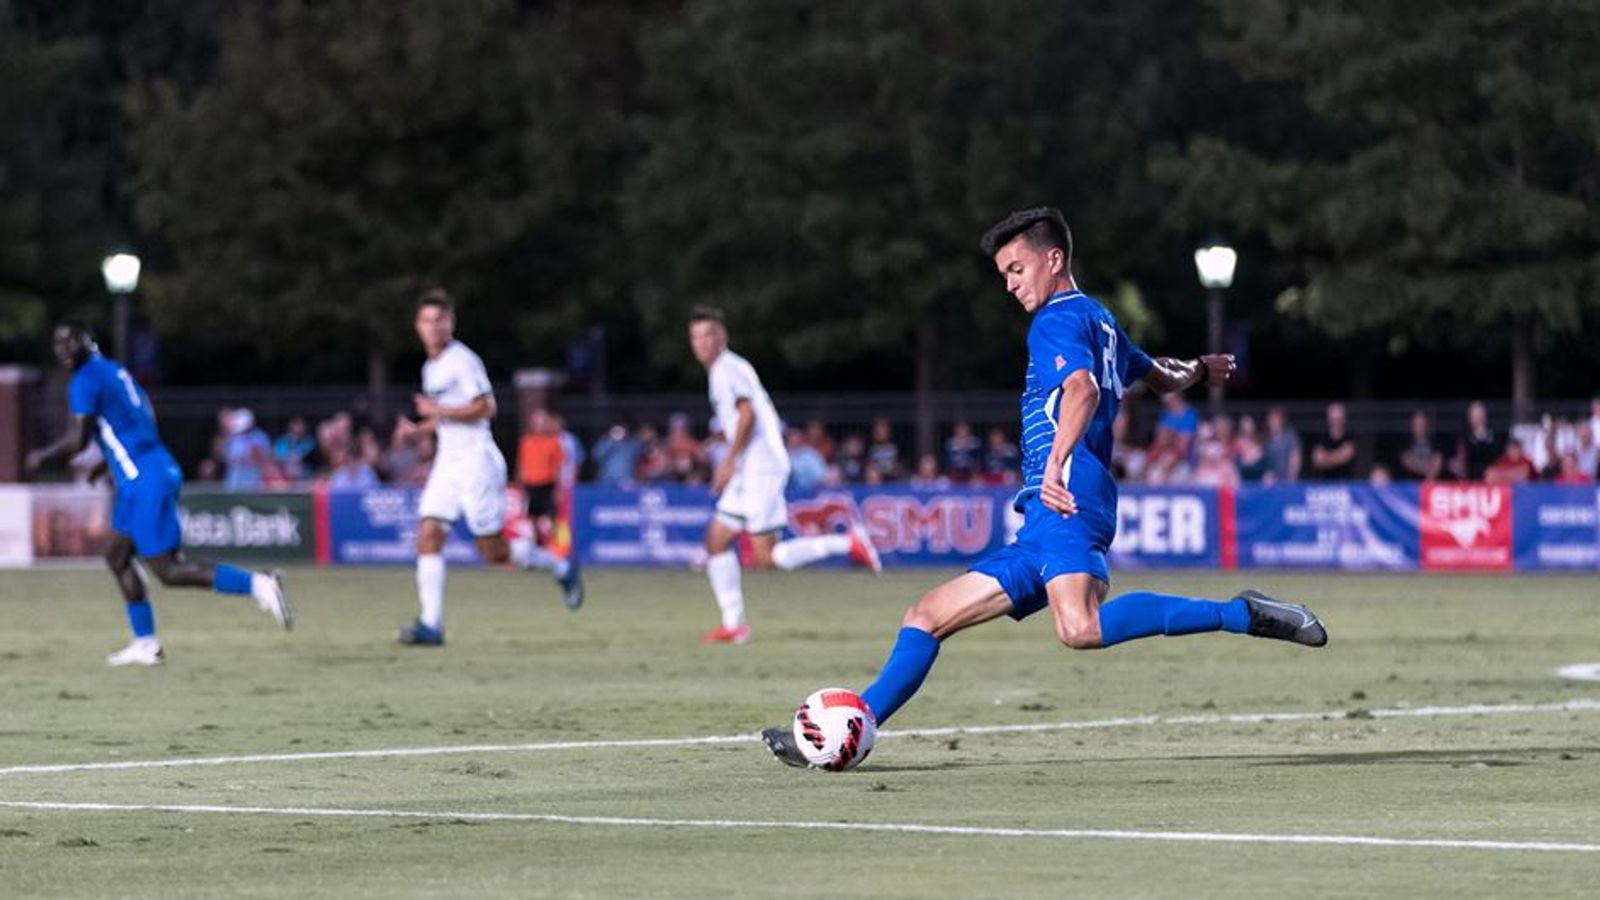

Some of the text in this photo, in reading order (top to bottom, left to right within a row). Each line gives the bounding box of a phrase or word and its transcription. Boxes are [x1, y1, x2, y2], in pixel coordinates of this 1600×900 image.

[1430, 485, 1502, 519] SMU
[231, 506, 301, 547] Bank
[863, 494, 993, 554] SMU
